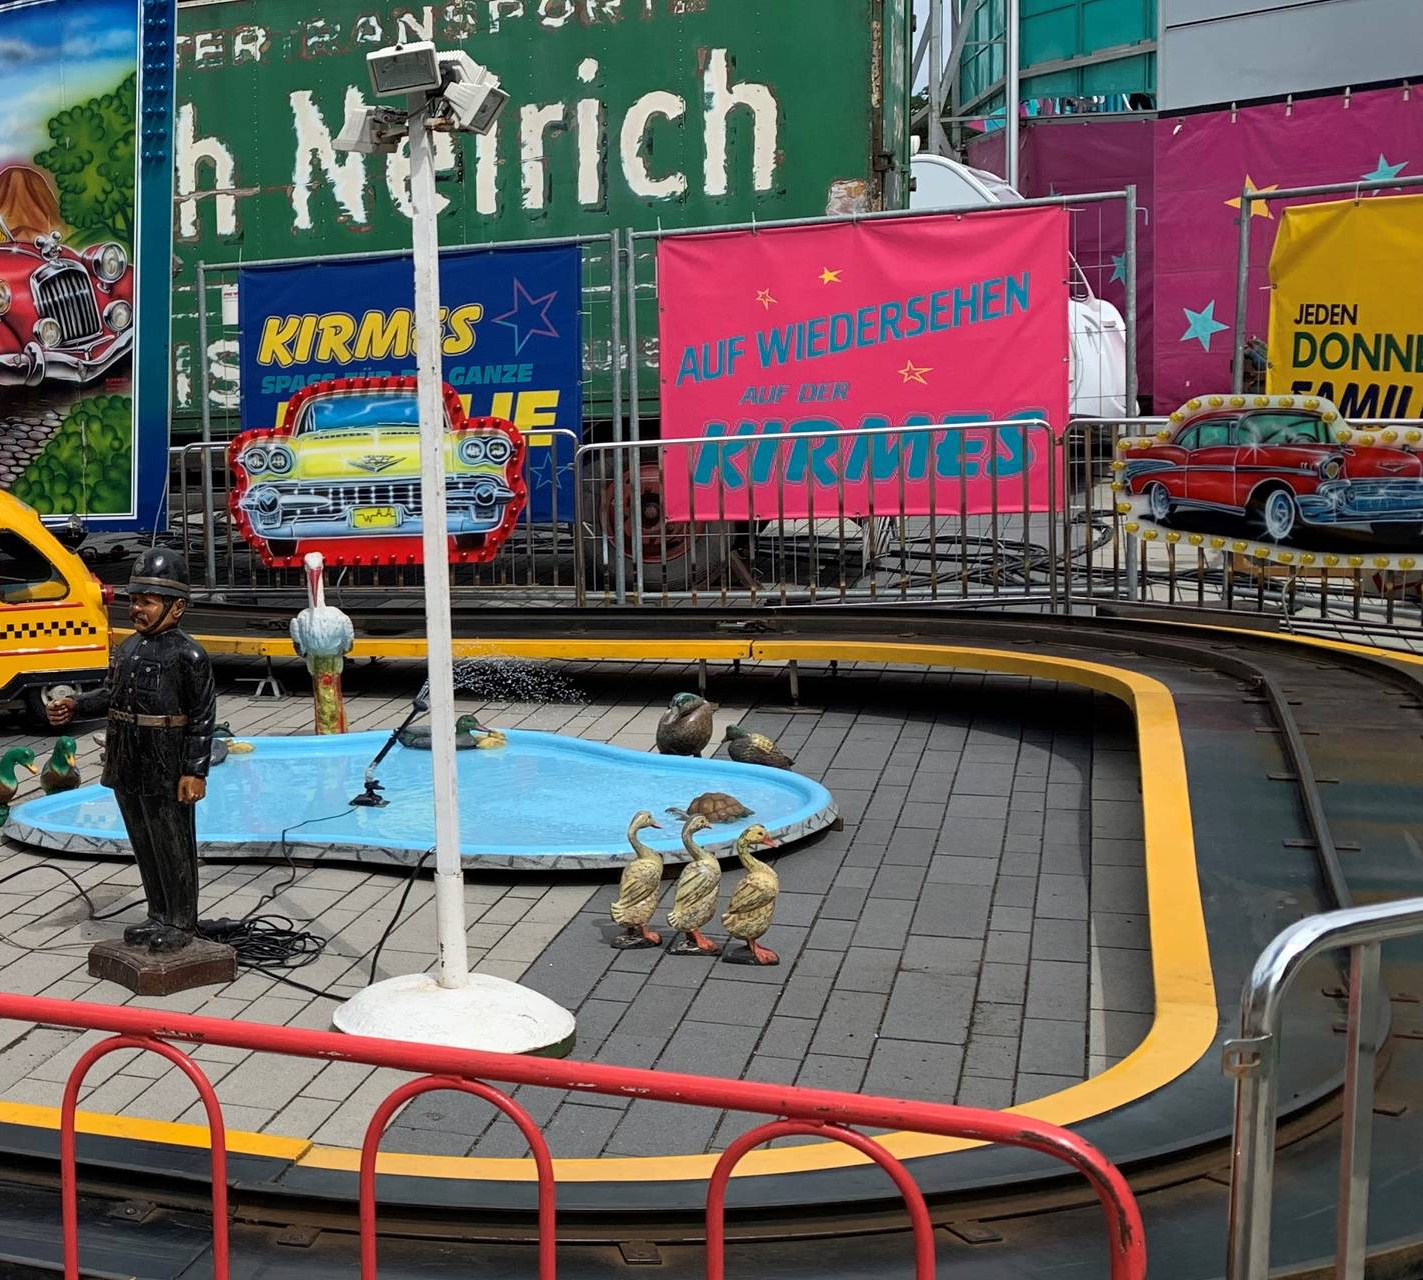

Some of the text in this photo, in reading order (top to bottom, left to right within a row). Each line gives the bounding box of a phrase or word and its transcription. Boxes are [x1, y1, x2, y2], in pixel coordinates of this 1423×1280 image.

[257, 303, 484, 368] KIRMS
[676, 335, 747, 386] AUF
[756, 271, 1031, 368] WIEDERSEHEN
[1293, 303, 1359, 326] JEDEN
[448, 363, 534, 386] GANZE
[739, 382, 849, 405] AUF DER
[690, 405, 1050, 491] KIRMES
